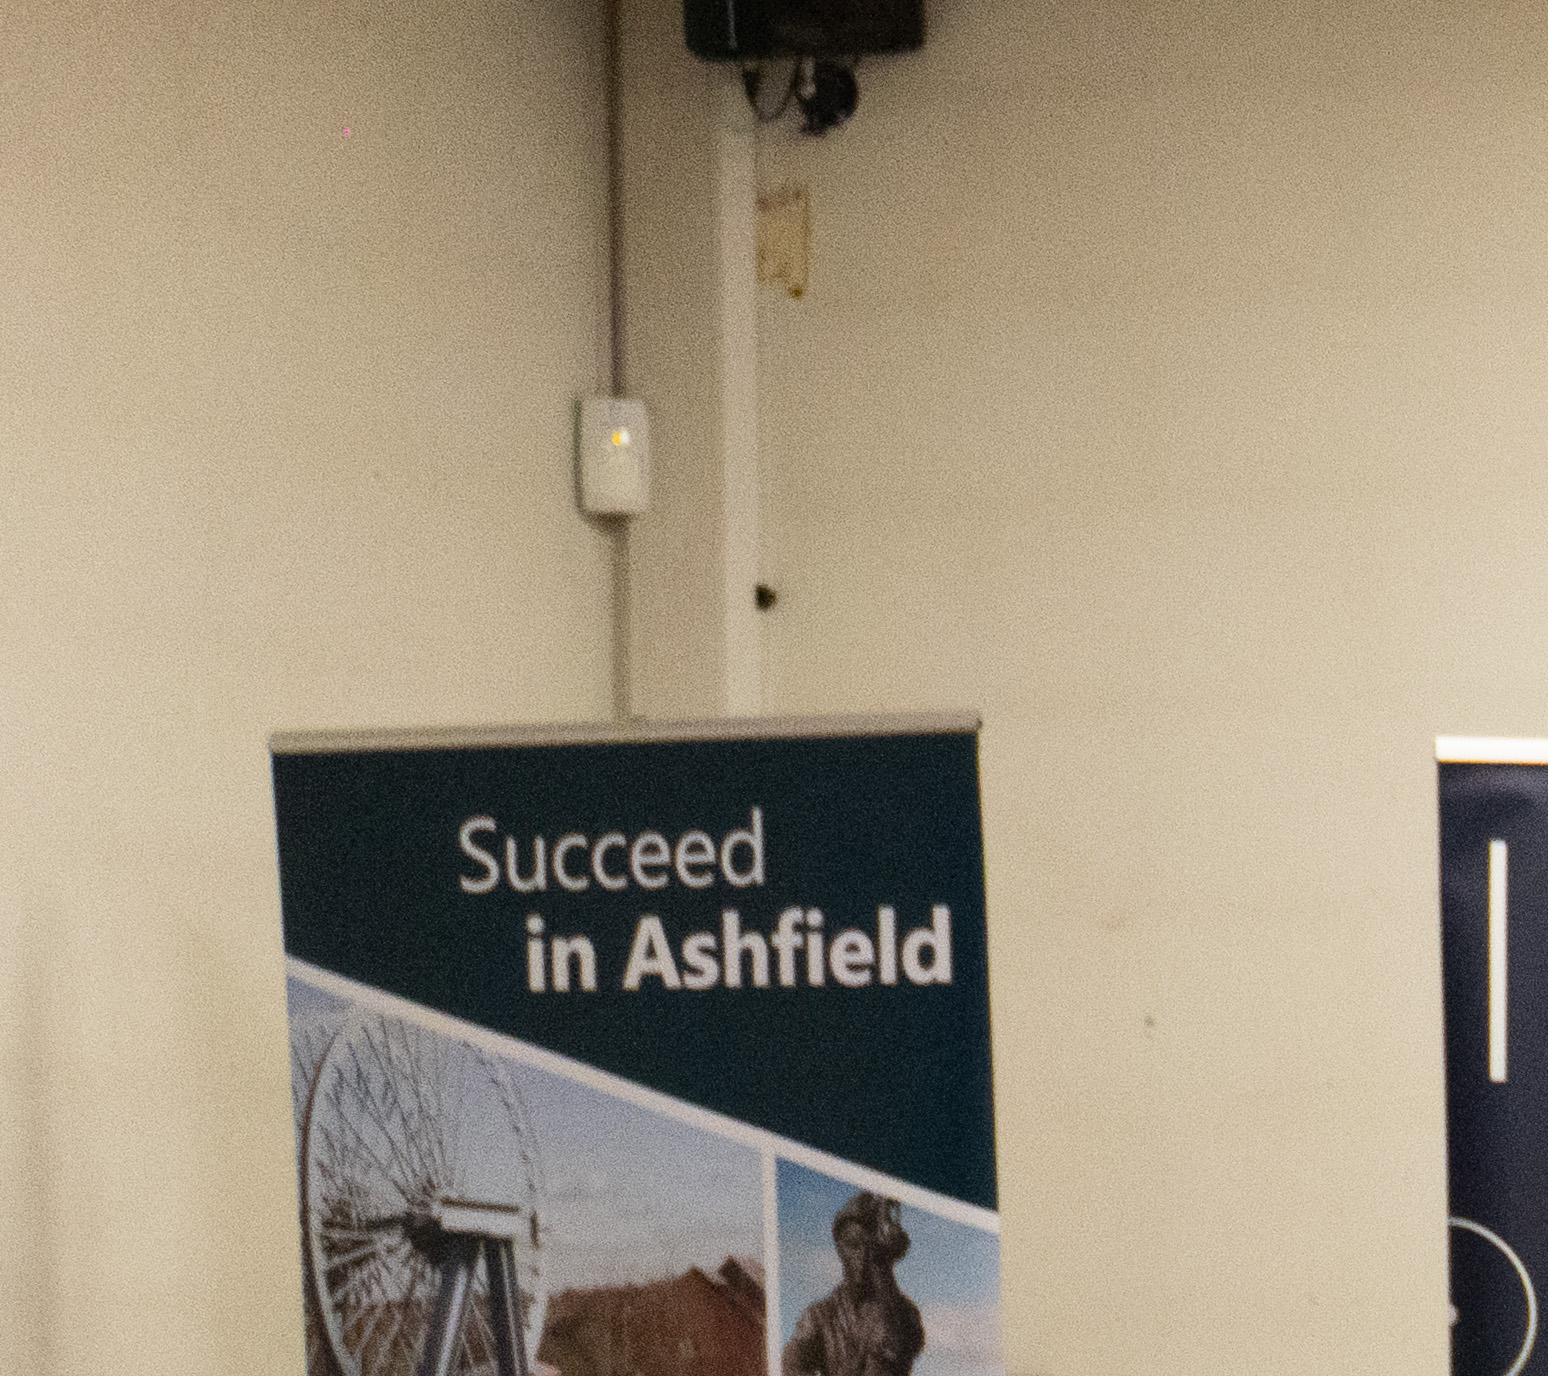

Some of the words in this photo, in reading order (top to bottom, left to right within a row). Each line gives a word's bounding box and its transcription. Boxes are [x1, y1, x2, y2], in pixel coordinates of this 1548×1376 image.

[458, 807, 767, 894] Succeed
[526, 913, 597, 992] in
[622, 904, 954, 990] Ashfield
